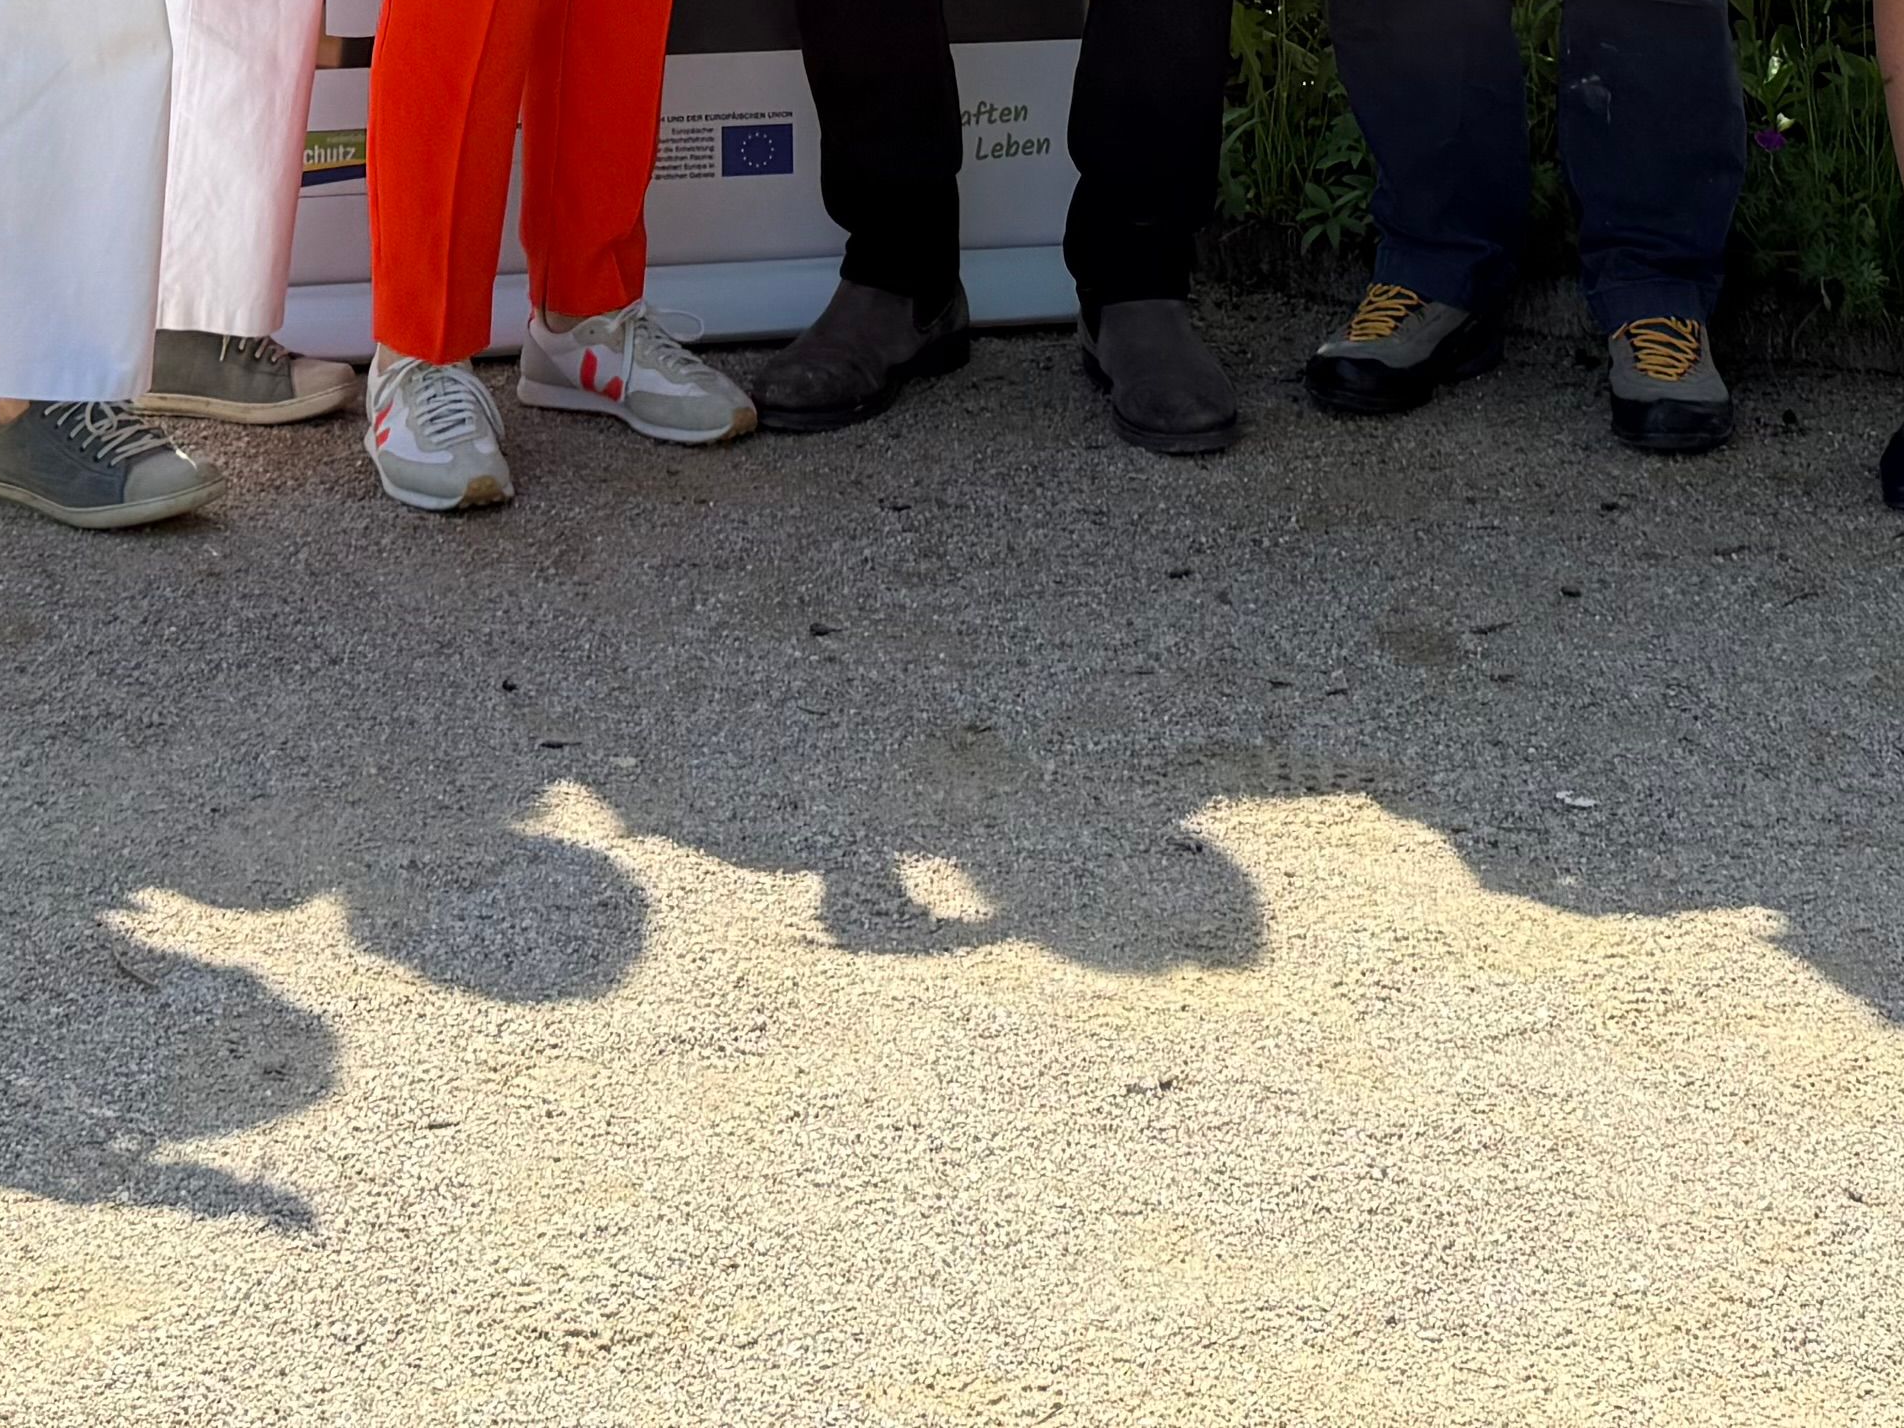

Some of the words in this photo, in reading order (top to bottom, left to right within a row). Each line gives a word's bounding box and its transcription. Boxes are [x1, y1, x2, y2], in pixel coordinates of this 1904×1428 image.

[960, 100, 1029, 127] aften
[303, 144, 356, 165] chutz
[975, 132, 1051, 161] Leben
